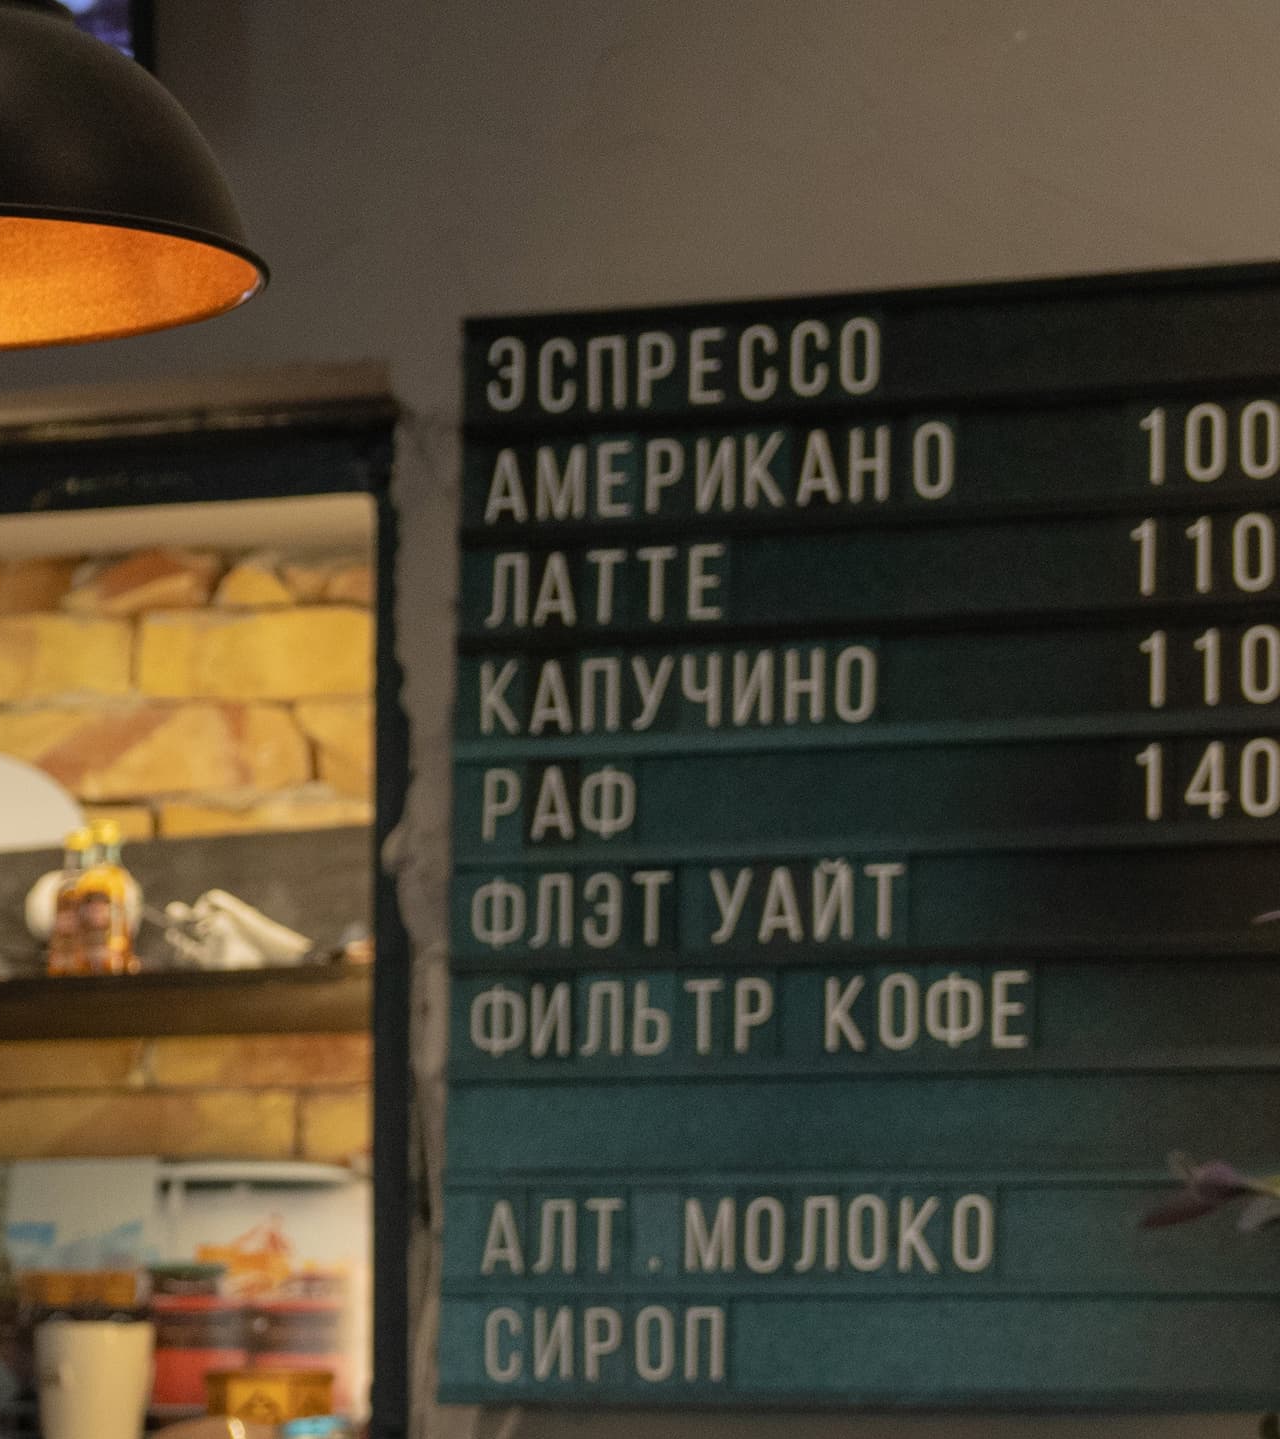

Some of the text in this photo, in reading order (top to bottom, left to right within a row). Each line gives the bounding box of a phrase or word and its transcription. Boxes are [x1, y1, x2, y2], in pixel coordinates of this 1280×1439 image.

[485, 315, 881, 413] ЭСПРЕССО
[484, 400, 1280, 523] АМЕРИКАНО 100
[484, 512, 1275, 629] ЛАТТЕ 110
[479, 624, 1280, 735] КАПУЧИНО 110
[481, 737, 1280, 841] РАФ 140
[470, 858, 905, 949] ФЛЭТ УАЙТ
[469, 969, 1029, 1057] ФИЛЬТР КОФЕ
[480, 1193, 995, 1275] АЛТ. МОЛОКО
[483, 1304, 726, 1384] СИРОП
